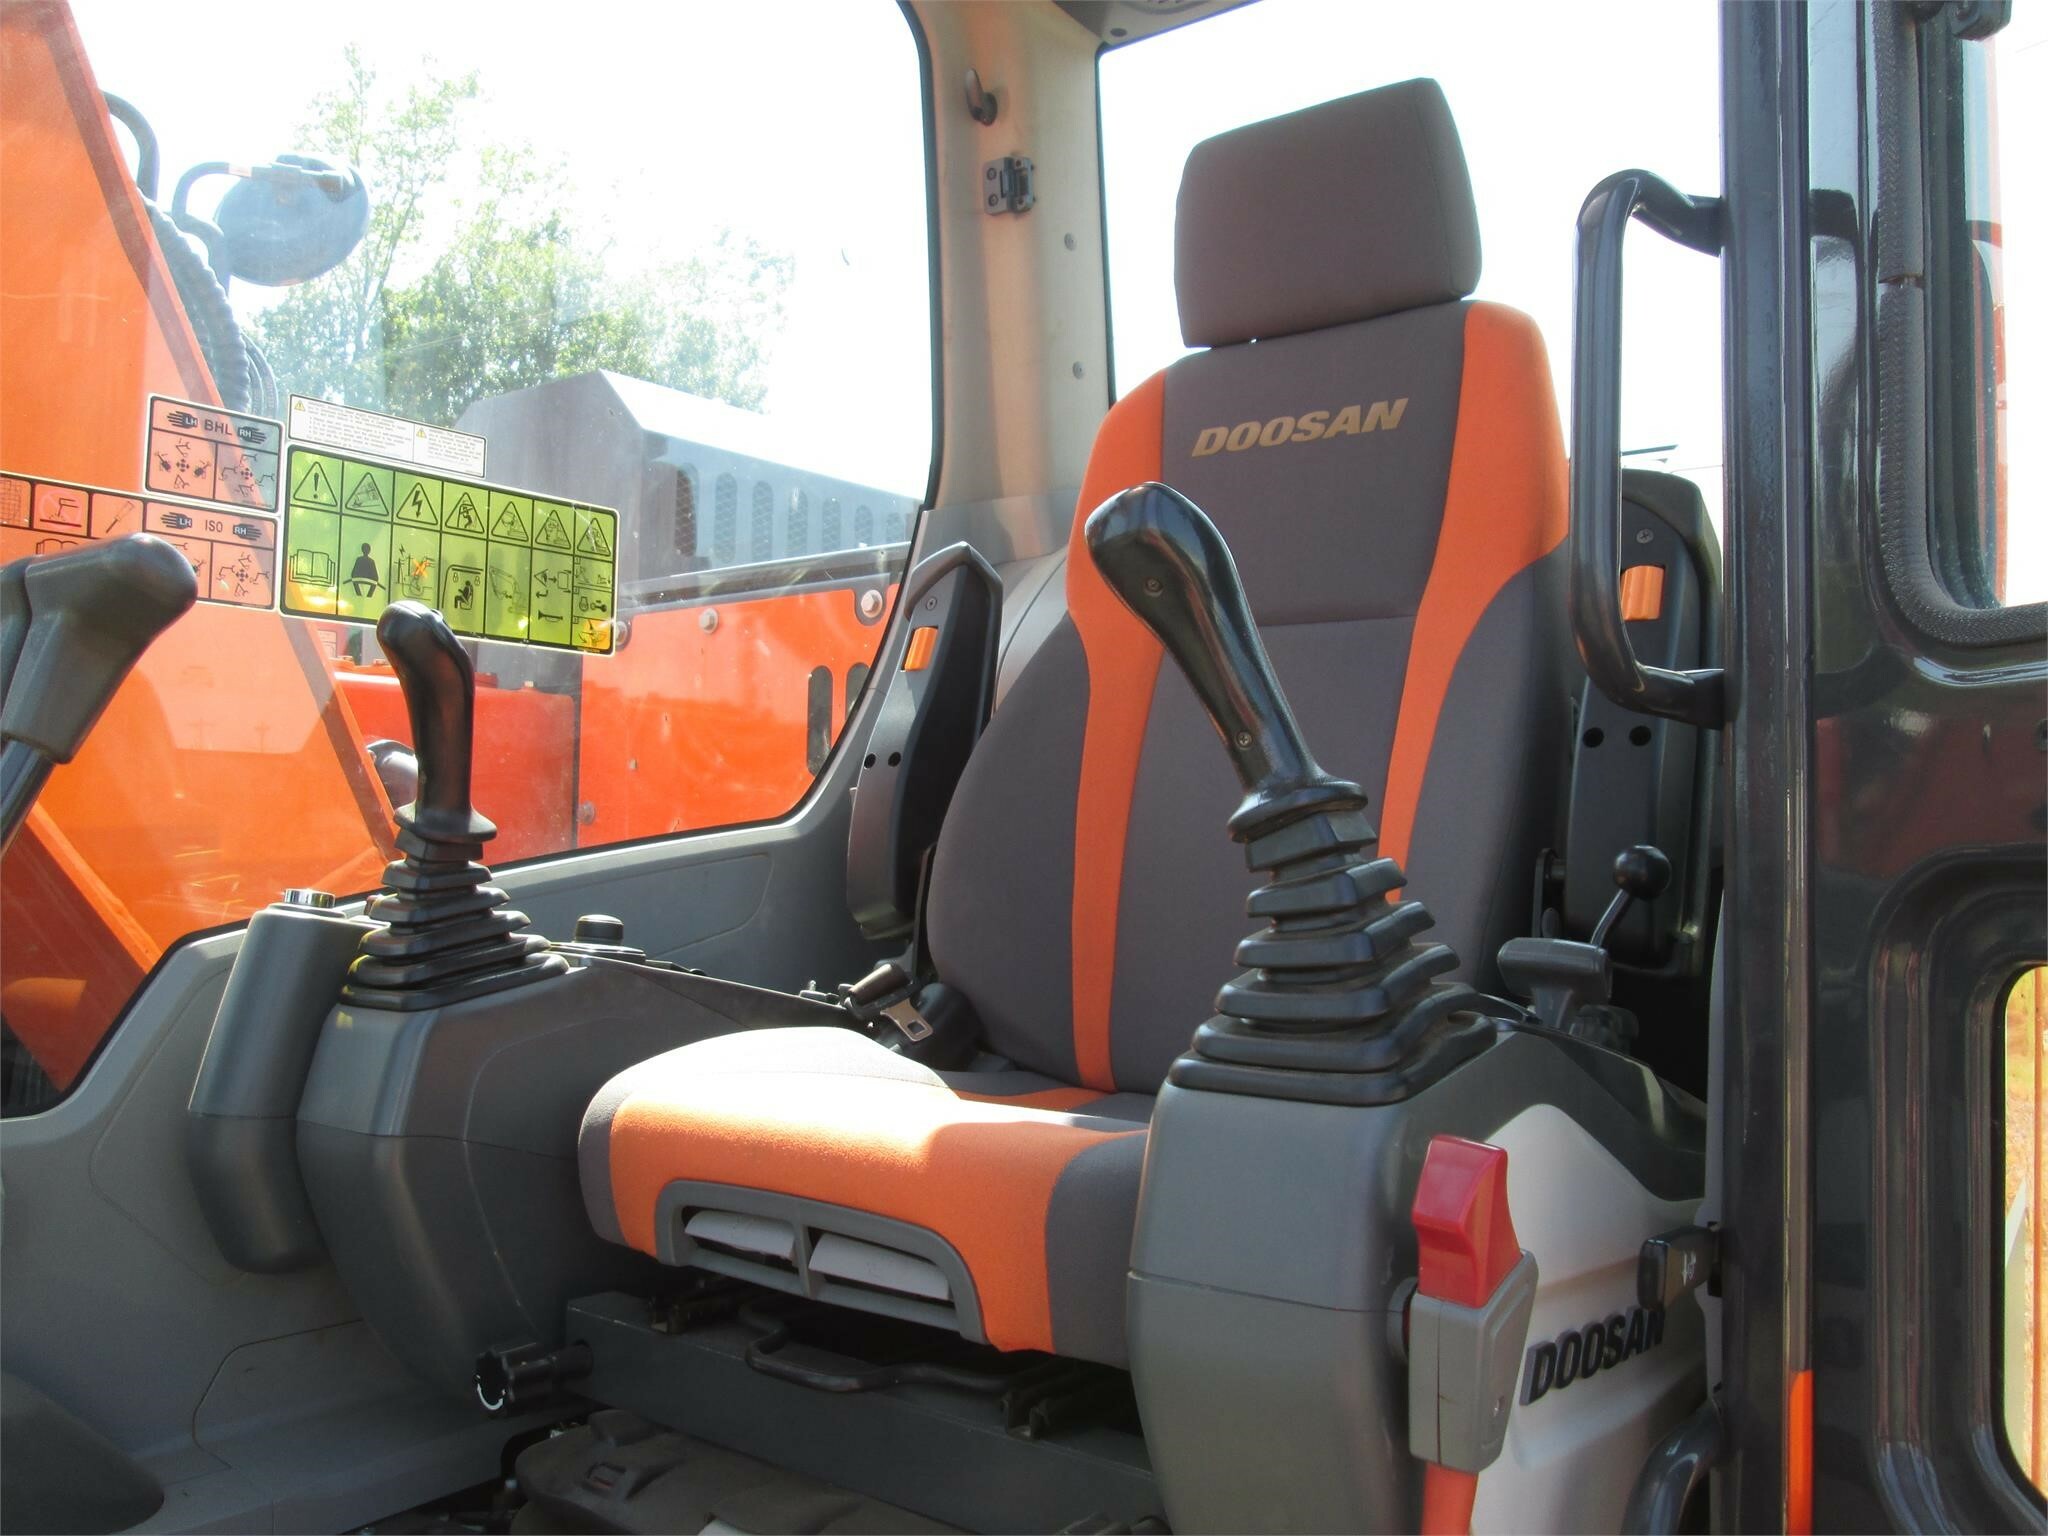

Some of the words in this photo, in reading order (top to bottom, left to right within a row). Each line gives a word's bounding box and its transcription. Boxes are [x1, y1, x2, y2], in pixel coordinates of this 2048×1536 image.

[185, 418, 197, 426] LH
[204, 420, 232, 435] BHL
[239, 428, 252, 438] RH
[1191, 397, 1409, 458] DOOSAN
[179, 518, 191, 526] LH
[204, 519, 224, 533] ISO
[234, 526, 247, 535] RH
[1519, 1305, 1666, 1406] DOOSAN
